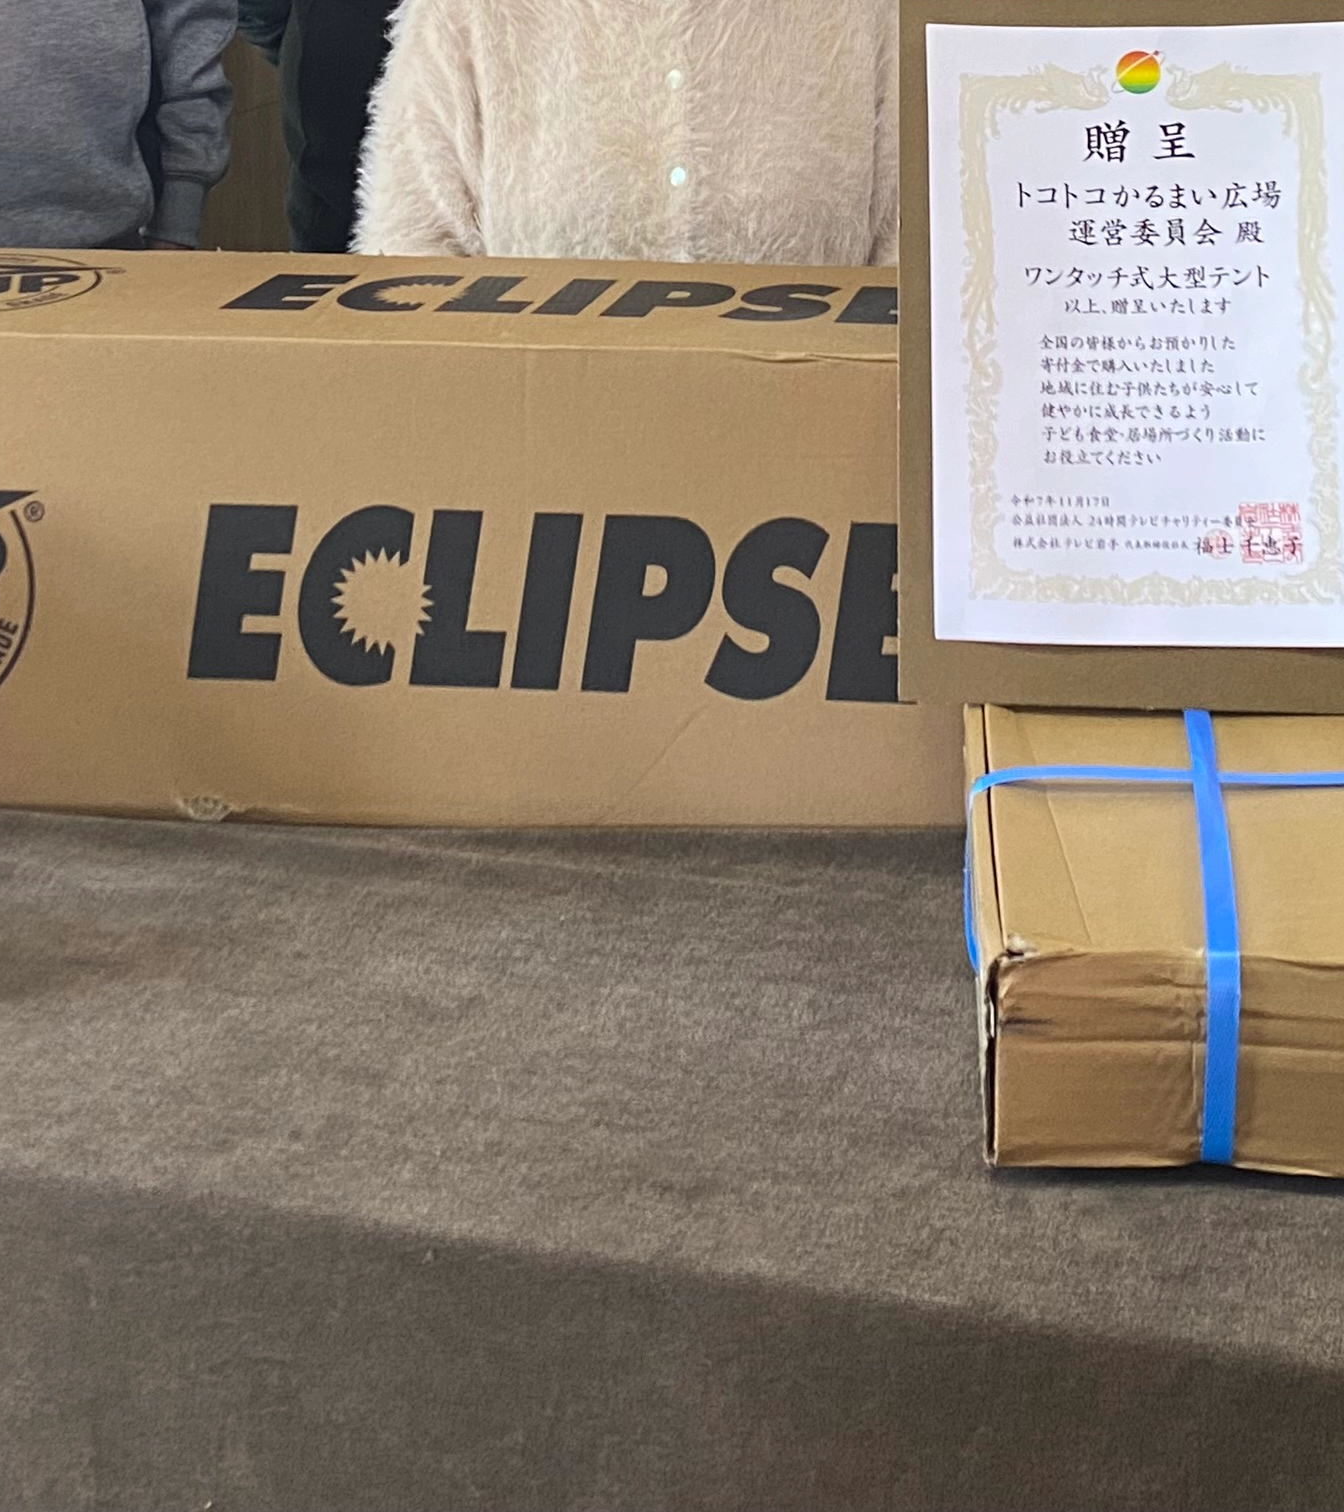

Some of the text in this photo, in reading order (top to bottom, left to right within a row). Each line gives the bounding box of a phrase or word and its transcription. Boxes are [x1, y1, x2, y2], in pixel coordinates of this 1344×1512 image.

[1017, 180, 1282, 209] トコトコかるまい広場
[1068, 218, 1265, 246] 運営委員会 殿
[1024, 265, 1270, 291] ワンタッチ式大型テント
[1064, 298, 1231, 315] 以上、贈呈いたします
[1040, 334, 1236, 351] 全国の皆様からお預かりした
[1040, 356, 1215, 374] 寄付金で購入いたしました
[1040, 380, 1259, 397] 地域に住む子供たちが安心して
[1041, 402, 1211, 420] 健やかに成長できるよう
[1042, 425, 1266, 443] 子ども食堂・居場所づくり活動に
[1043, 449, 1162, 466] お役立てください
